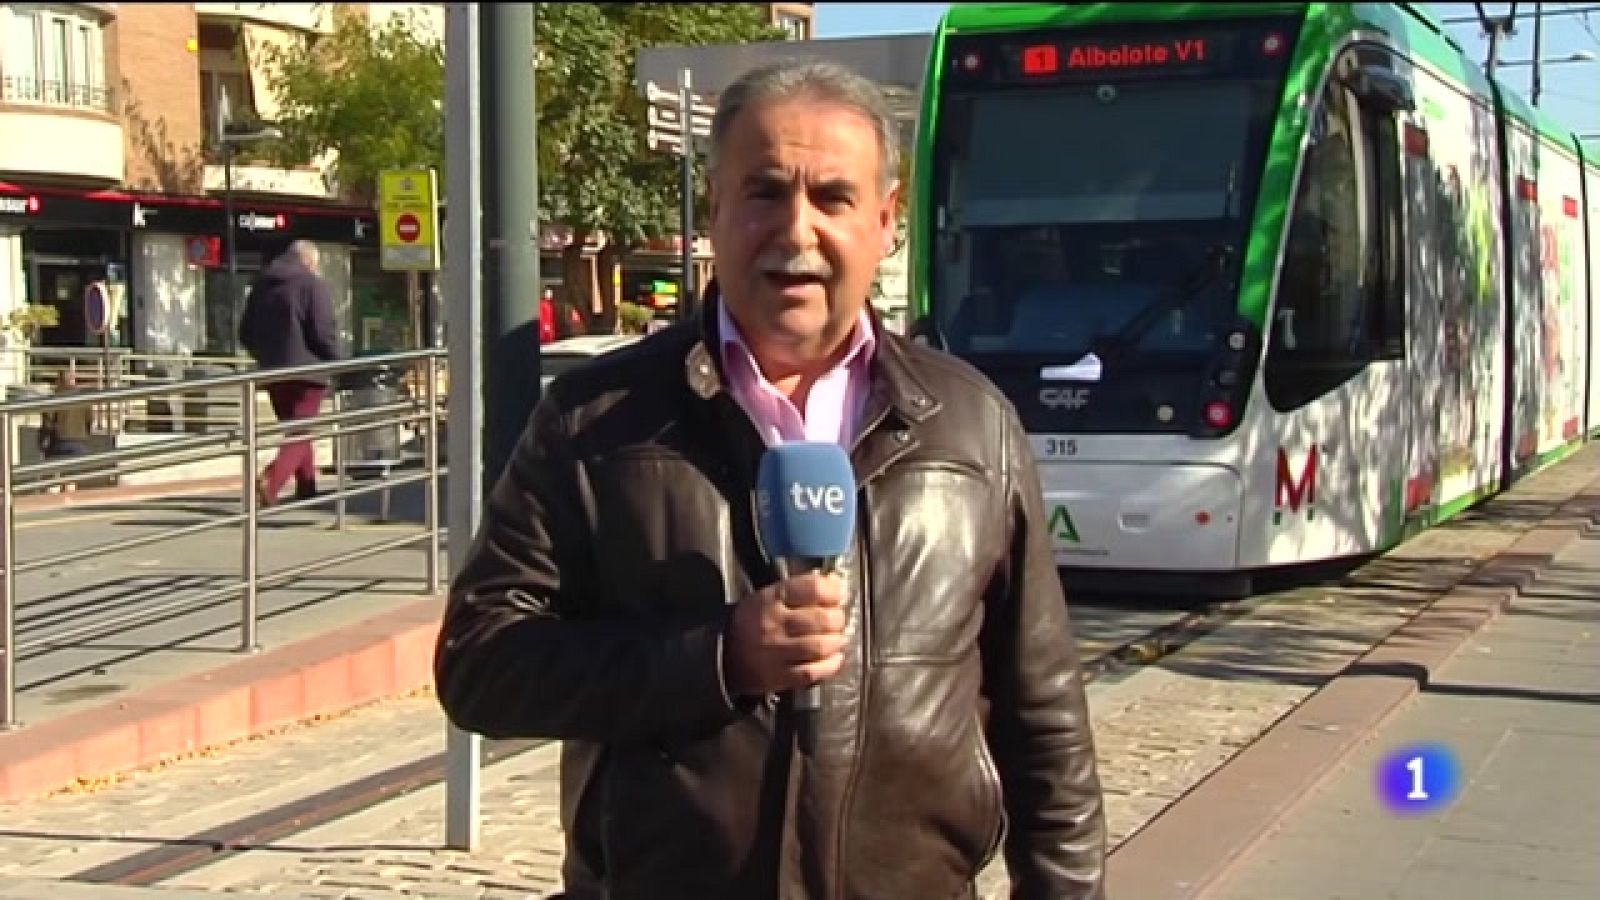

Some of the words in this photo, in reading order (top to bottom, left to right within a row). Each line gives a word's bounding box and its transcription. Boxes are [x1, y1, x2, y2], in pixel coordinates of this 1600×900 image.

[1068, 45, 1168, 67] Albolote
[1175, 39, 1204, 60] V1
[1045, 438, 1077, 455] 315
[1273, 442, 1317, 522] M
[790, 482, 844, 513] tve
